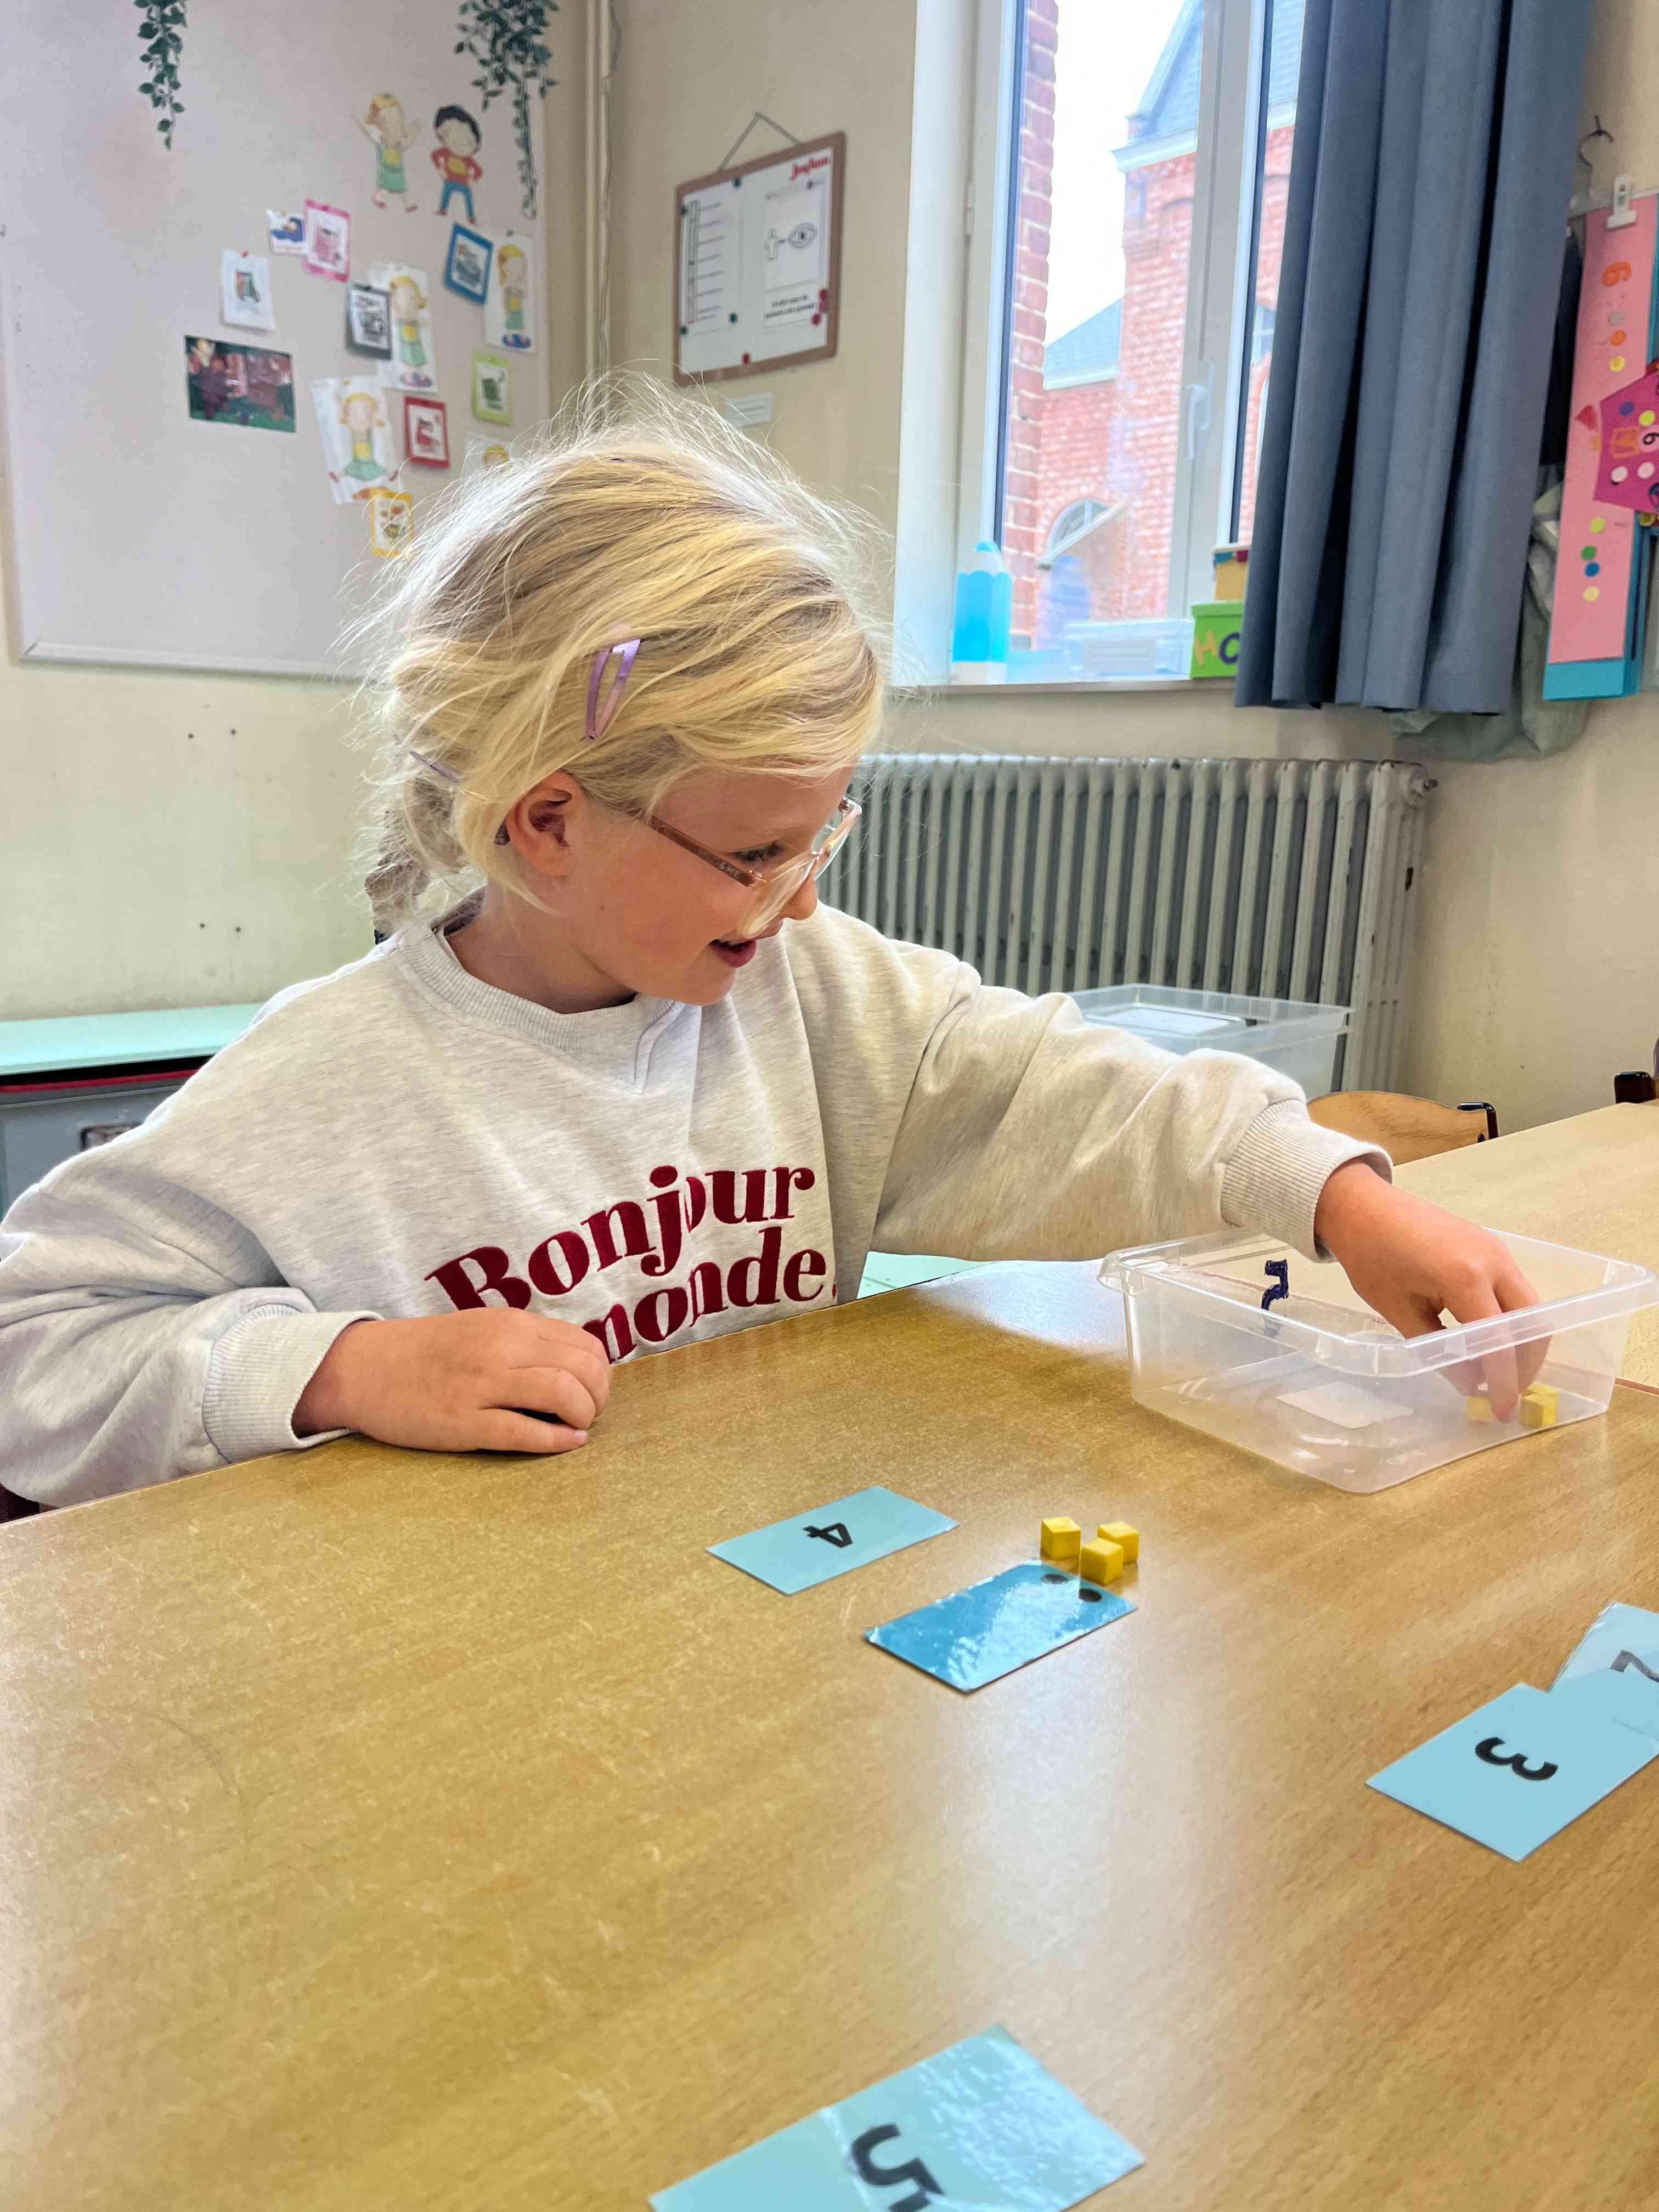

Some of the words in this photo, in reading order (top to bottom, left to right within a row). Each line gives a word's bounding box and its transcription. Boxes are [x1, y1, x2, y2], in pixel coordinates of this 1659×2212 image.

[803, 1522, 853, 1548] 4
[1475, 1737, 1558, 1781] 3
[851, 2124, 945, 2212] 5
